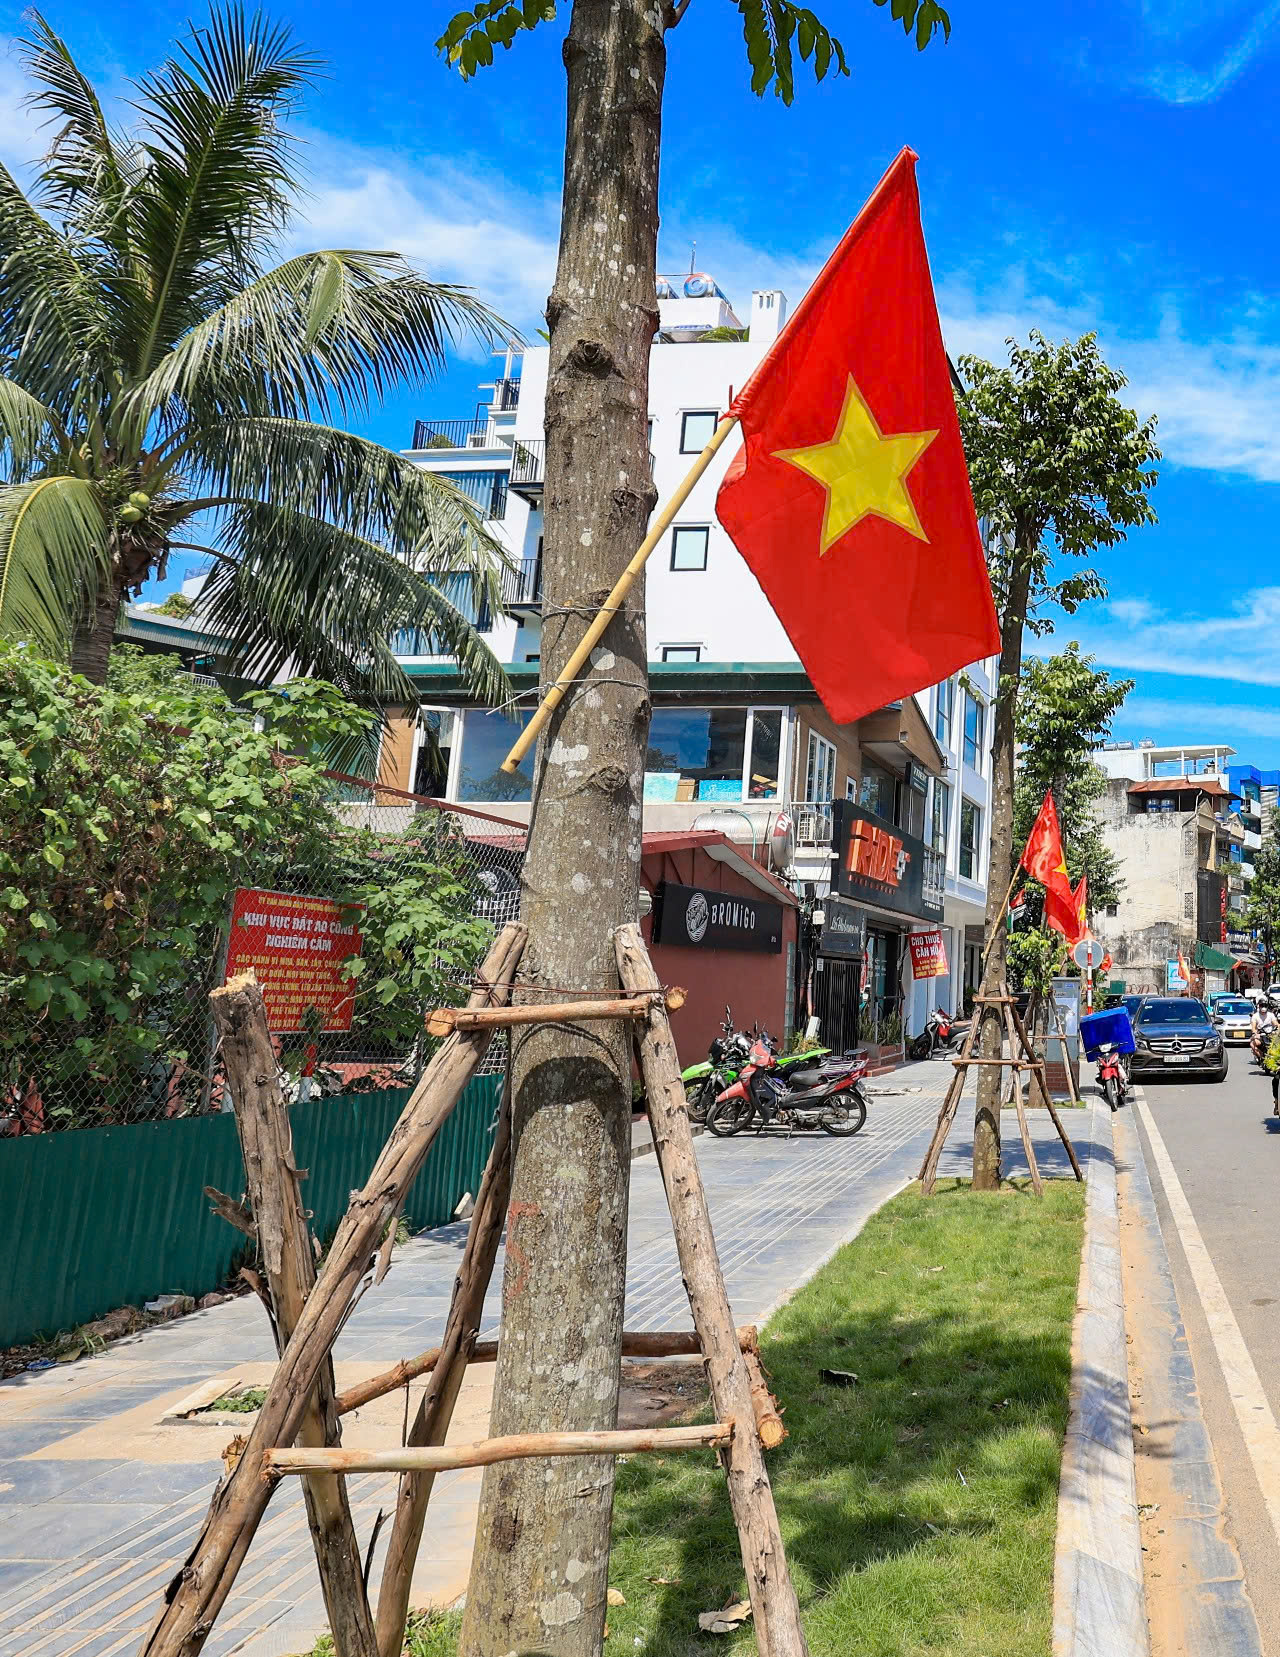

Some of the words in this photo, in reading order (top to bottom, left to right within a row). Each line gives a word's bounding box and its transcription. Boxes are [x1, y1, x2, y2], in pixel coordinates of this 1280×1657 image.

[244, 912, 267, 927] KHU
[269, 914, 290, 931] VỰC
[292, 913, 313, 931] ĐẤT
[314, 920, 328, 933] AO
[265, 934, 308, 950] NGHIÊM
[309, 935, 332, 952] CẤM
[911, 936, 924, 946] CHO
[924, 933, 941, 945] THUÊ
[915, 946, 930, 958] CĂN
